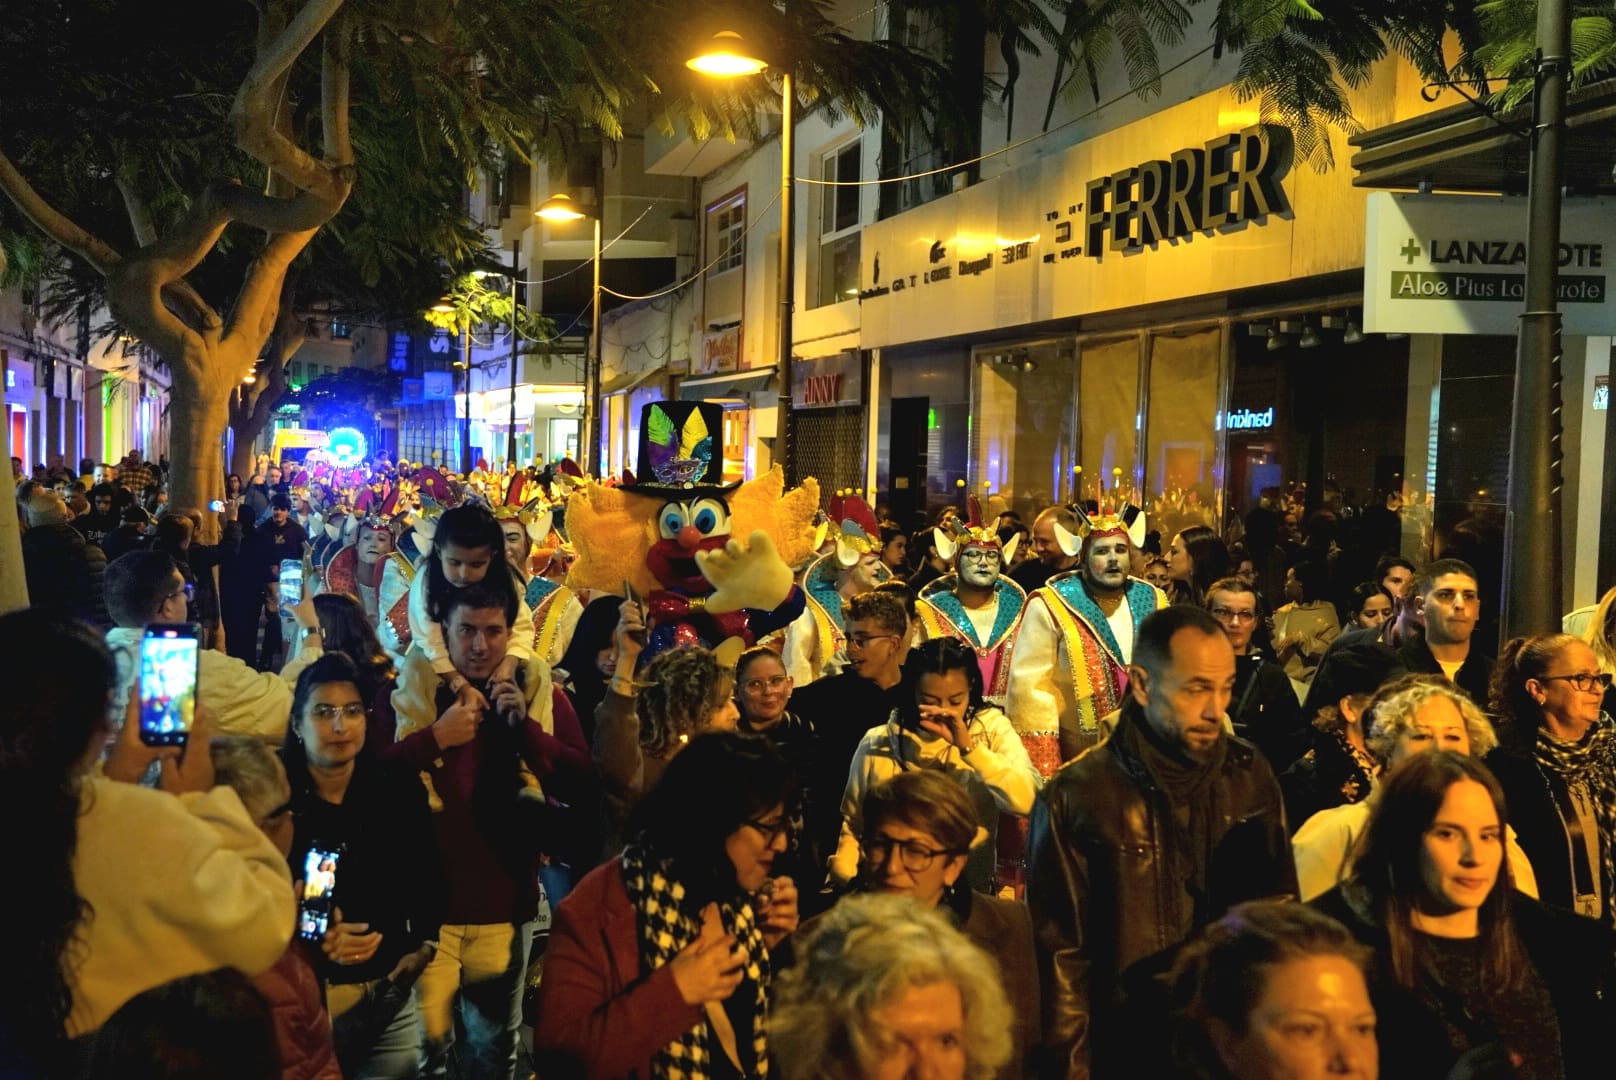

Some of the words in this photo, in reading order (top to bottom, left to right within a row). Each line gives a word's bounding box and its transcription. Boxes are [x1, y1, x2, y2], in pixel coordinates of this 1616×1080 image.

[1085, 123, 1295, 259] FERRER
[1430, 239, 1602, 267] LANZAOTE
[1398, 273, 1449, 296] Aloe
[1455, 276, 1495, 297] Plus
[1501, 279, 1601, 299] Larote
